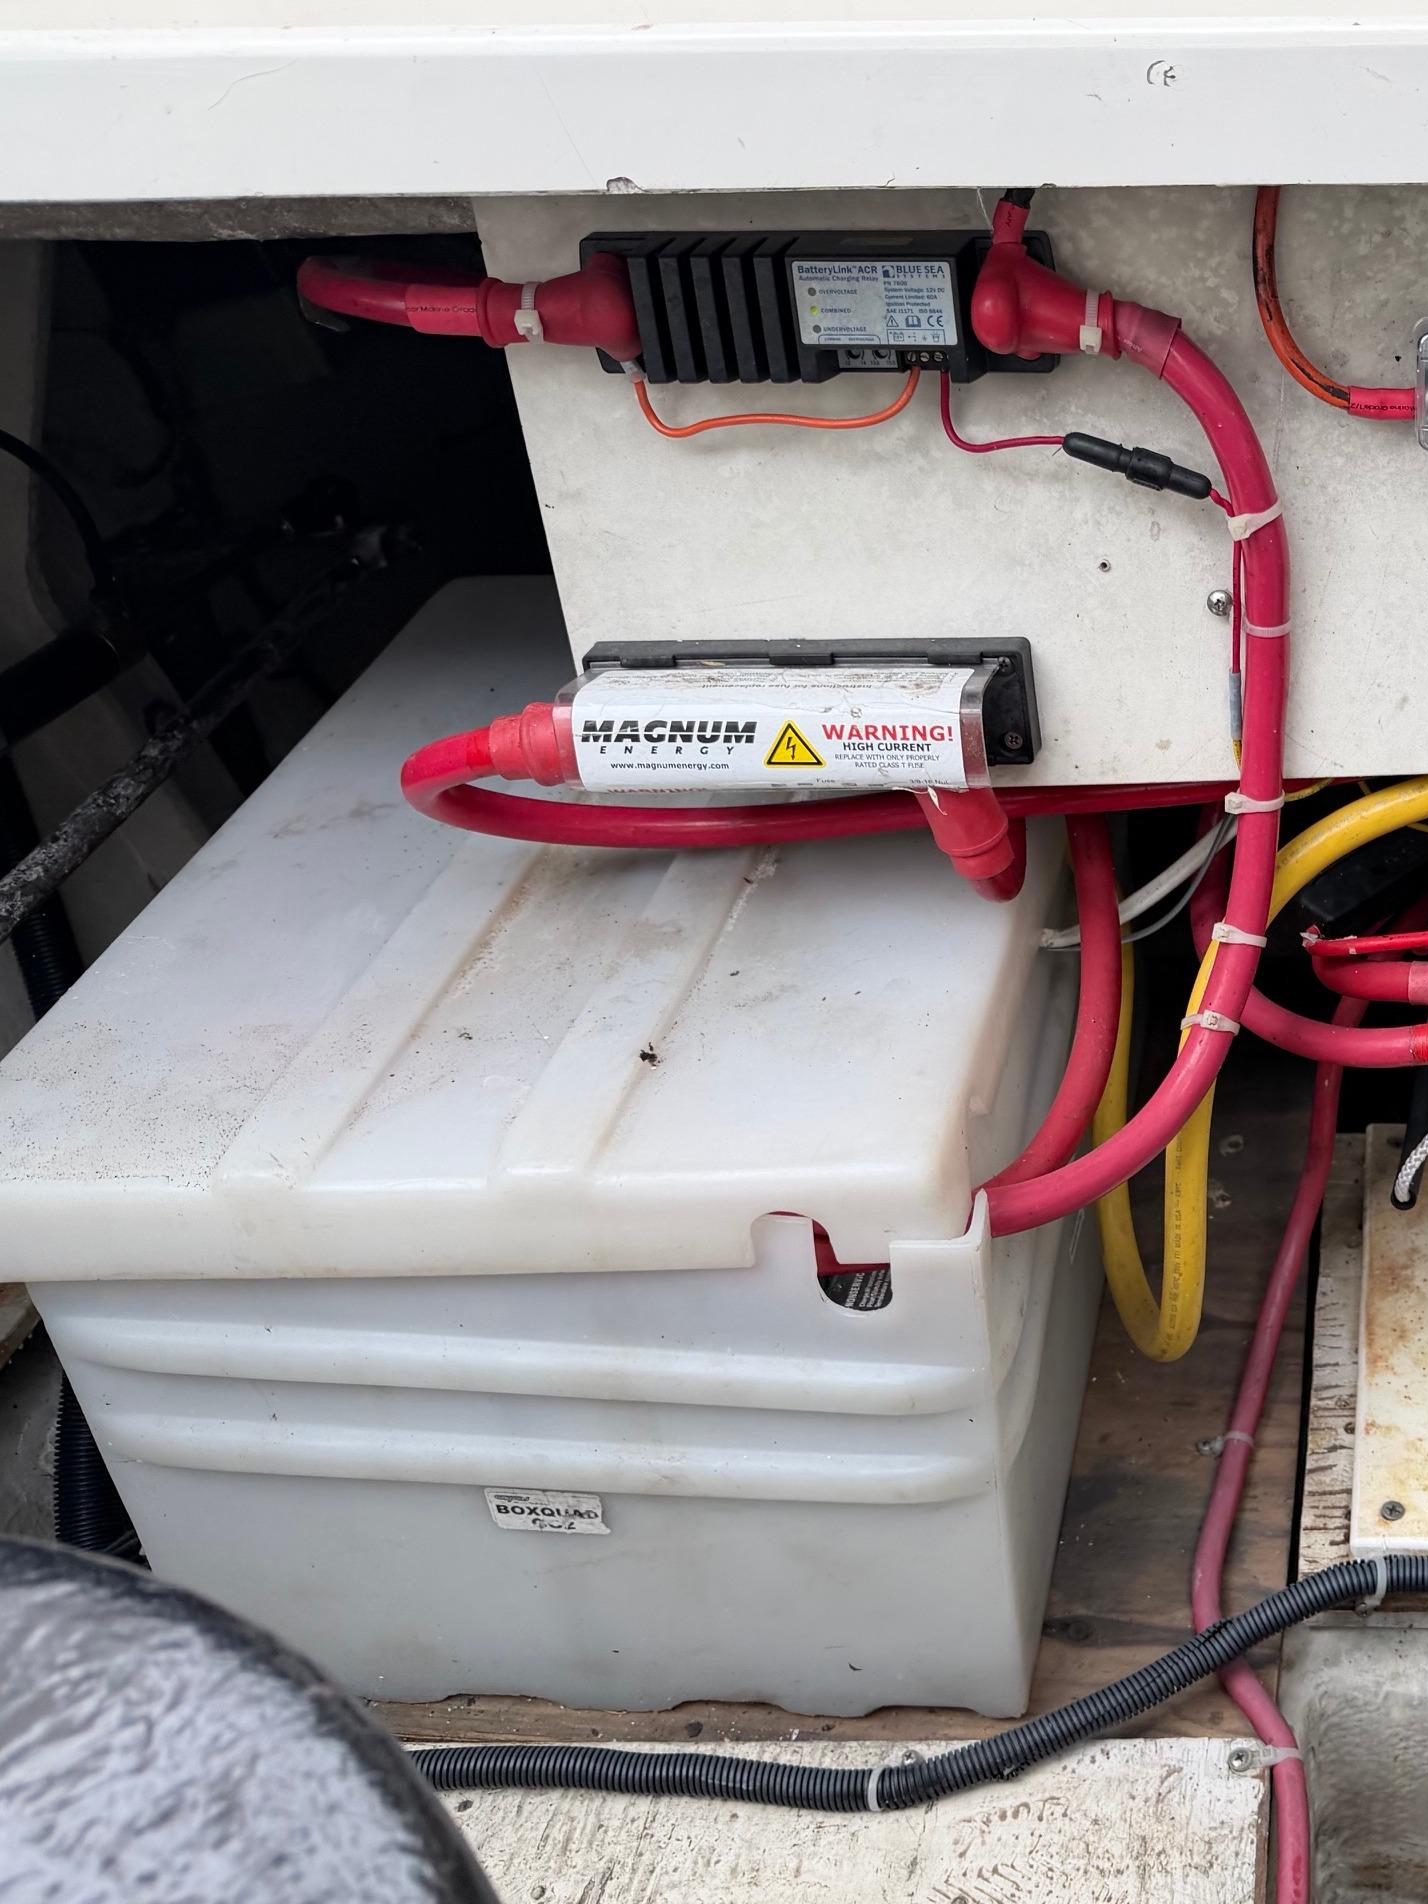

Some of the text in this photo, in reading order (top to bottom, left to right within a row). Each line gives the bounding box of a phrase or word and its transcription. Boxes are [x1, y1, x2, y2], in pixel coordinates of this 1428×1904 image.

[857, 265, 878, 274] ACR
[896, 265, 945, 274] BLUE SEA
[581, 720, 757, 743] MAGNUM
[821, 724, 954, 742] WARNING!
[599, 746, 735, 755] ENERGY
[843, 742, 931, 752] HIGH CURRENT
[610, 762, 730, 770] www.magnumenergy.com
